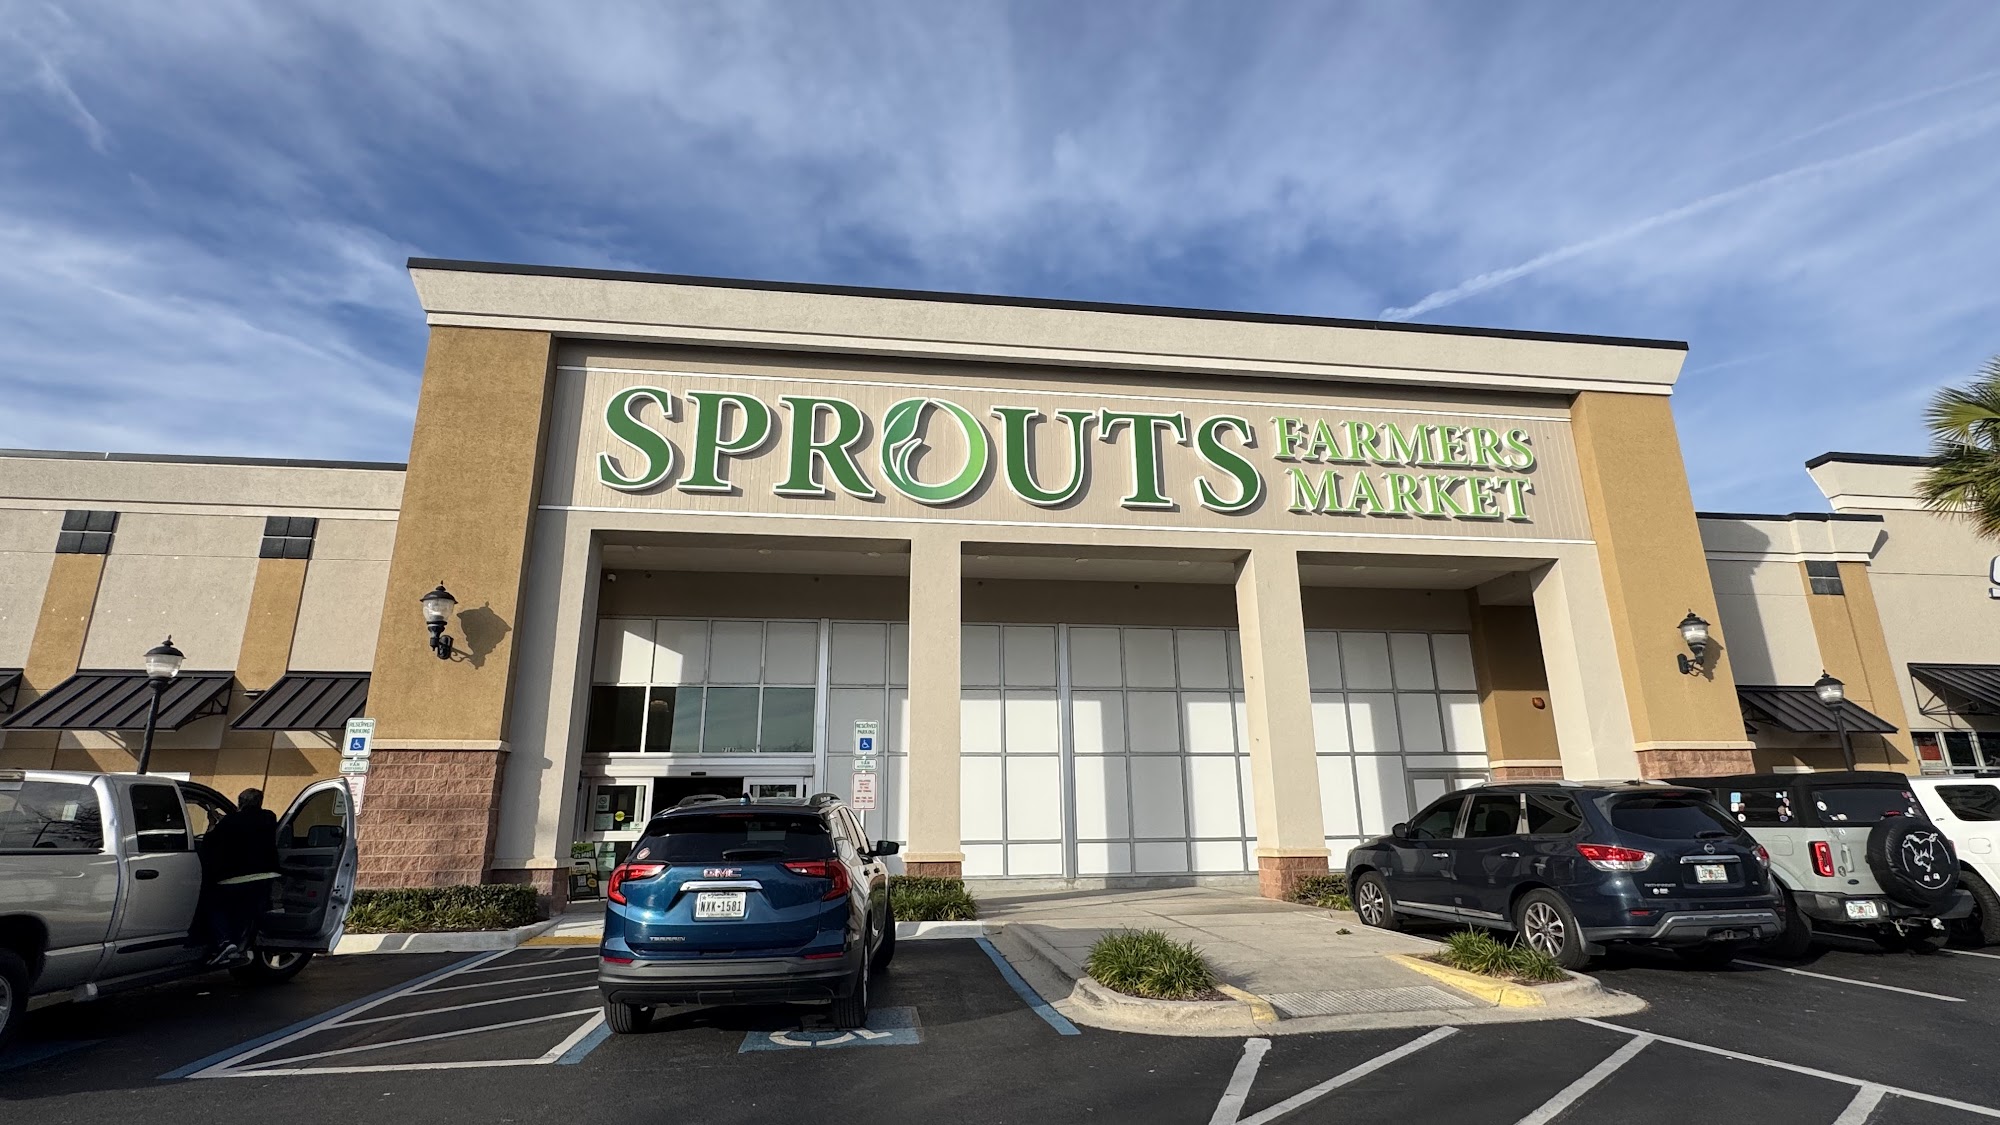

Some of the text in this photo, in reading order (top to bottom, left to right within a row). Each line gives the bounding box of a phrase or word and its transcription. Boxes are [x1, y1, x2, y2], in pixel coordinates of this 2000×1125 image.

[596, 385, 1261, 512] SPROUTS
[1269, 416, 1535, 469] FARMERS
[1284, 467, 1532, 520] MARKET
[703, 867, 742, 878] GMC
